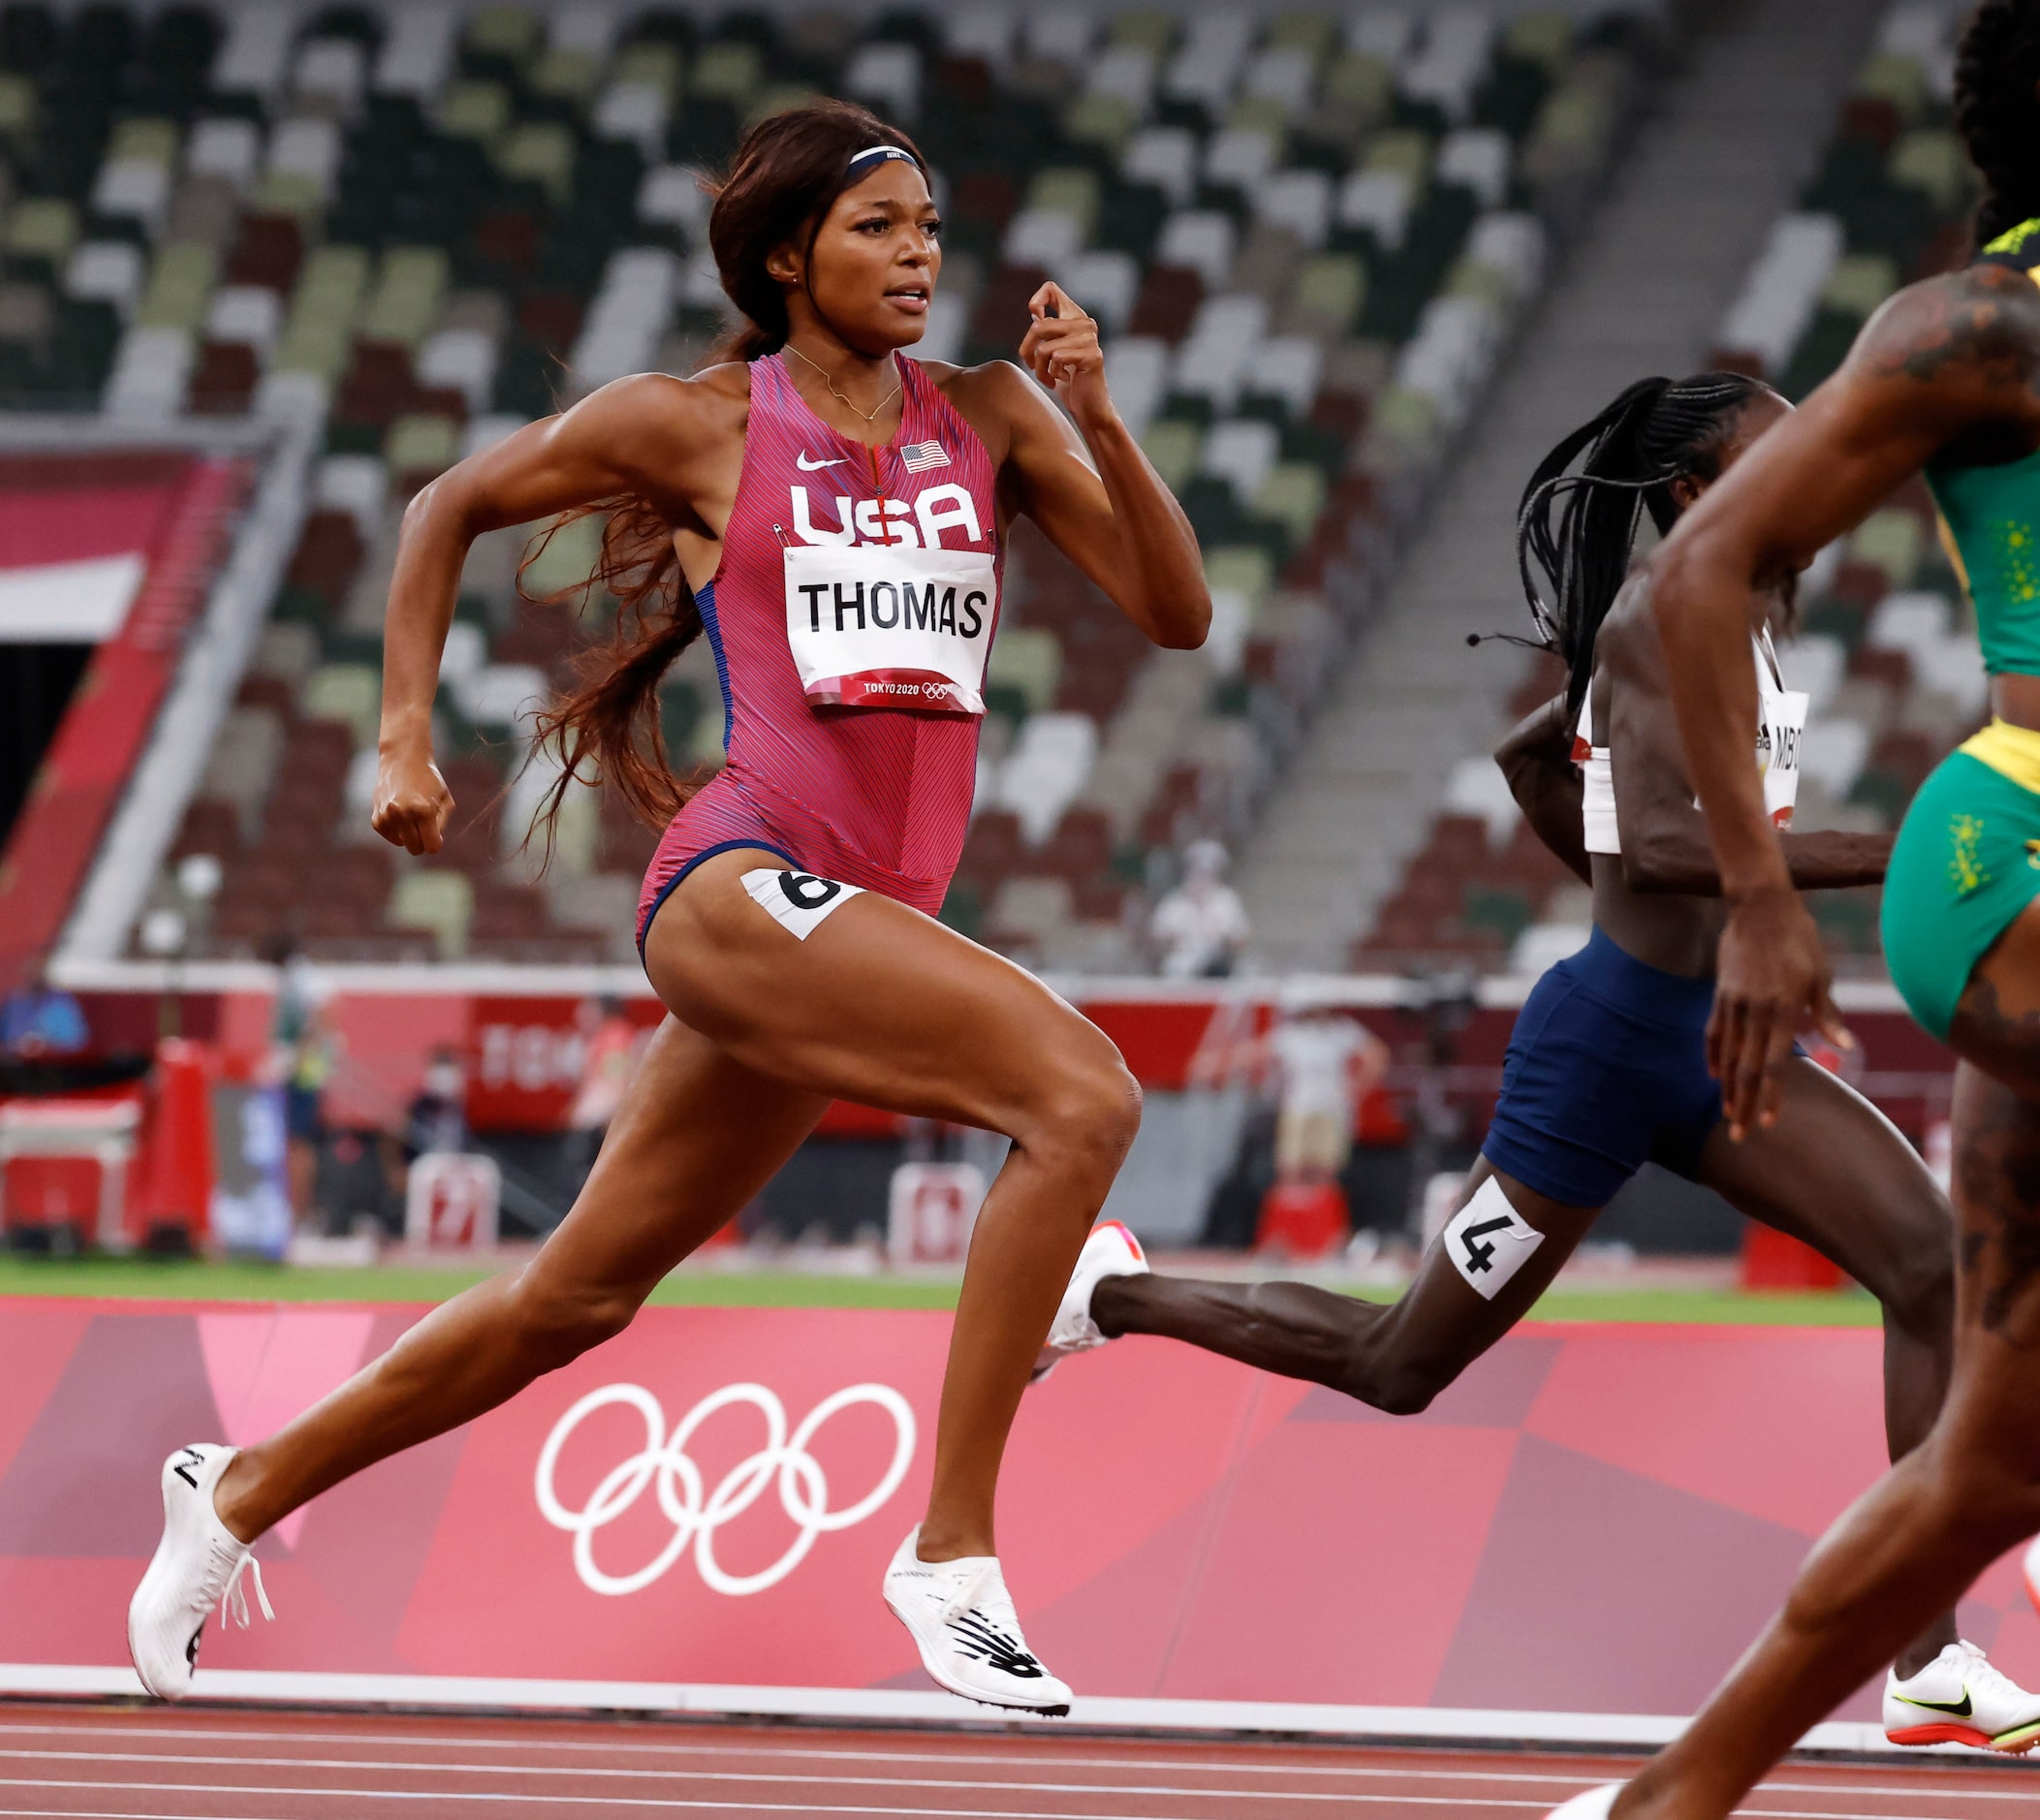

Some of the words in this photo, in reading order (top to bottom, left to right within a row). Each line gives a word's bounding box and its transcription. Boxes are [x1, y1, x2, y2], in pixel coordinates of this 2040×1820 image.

[790, 483, 983, 549] USA
[798, 581, 988, 640] THOMAS
[863, 681, 895, 695] TOKYO
[896, 683, 920, 696] 2020
[777, 870, 841, 910] 6
[1459, 1214, 1516, 1275] 4
